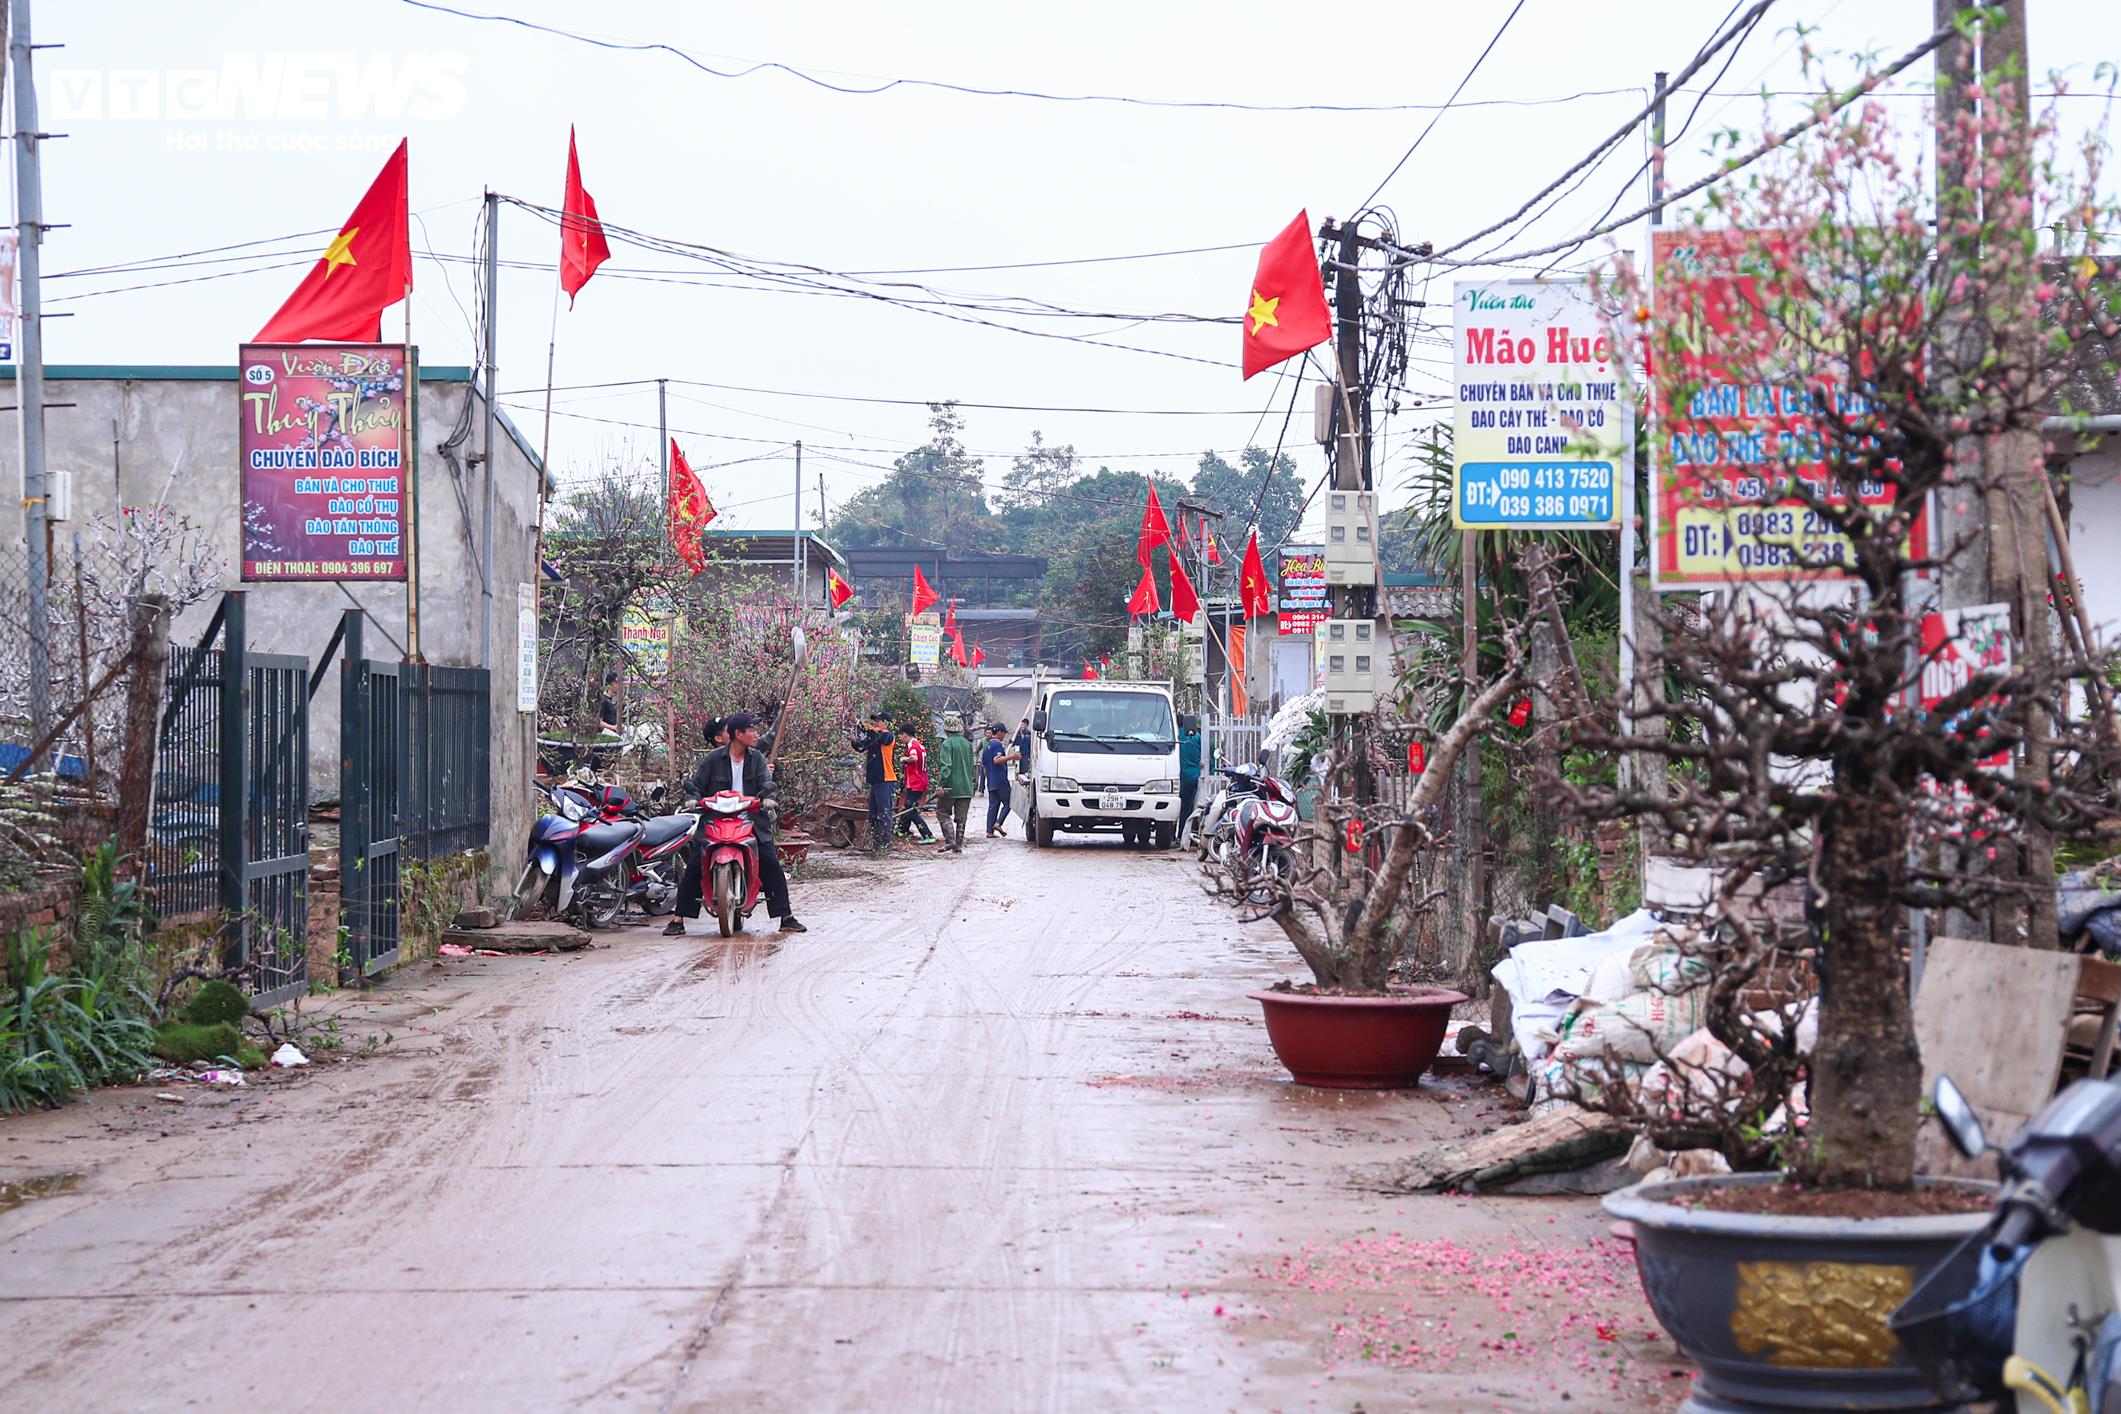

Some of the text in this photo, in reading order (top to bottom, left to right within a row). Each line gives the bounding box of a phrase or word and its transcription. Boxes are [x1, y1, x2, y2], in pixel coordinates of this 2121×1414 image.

[1466, 327, 1613, 373] Mão Huệ
[249, 367, 272, 381] SỐ 5
[1460, 380, 1506, 401] CHUYÊN
[1510, 380, 1534, 401] BÁN
[1558, 382, 1582, 401] CHO
[1586, 380, 1617, 401] THUÊ
[1471, 407, 1495, 428] ĐÀO
[1500, 407, 1522, 428] CÂY
[1526, 403, 1548, 427] THẾ
[1588, 402, 1604, 427] CỔ
[1507, 433, 1531, 454] ĐÀO
[251, 446, 399, 468] CHUYÊN ĐÀO BÍCH
[296, 477, 398, 493] BÁN VÀ CHO THUÊ
[1466, 468, 1610, 505] ĐT: 090 413 7520
[329, 495, 398, 517] ĐÀO CỔ THỤ
[1500, 495, 1608, 517] 039 386 0971
[306, 518, 398, 534] ĐÀO TÁN THÔNG
[1685, 525, 1717, 557] ĐT:
[1738, 512, 1793, 536] 0983
[349, 536, 399, 555] ĐÀO THẾ
[255, 560, 394, 577] ĐIỆN THOẠI: 0904 396 697
